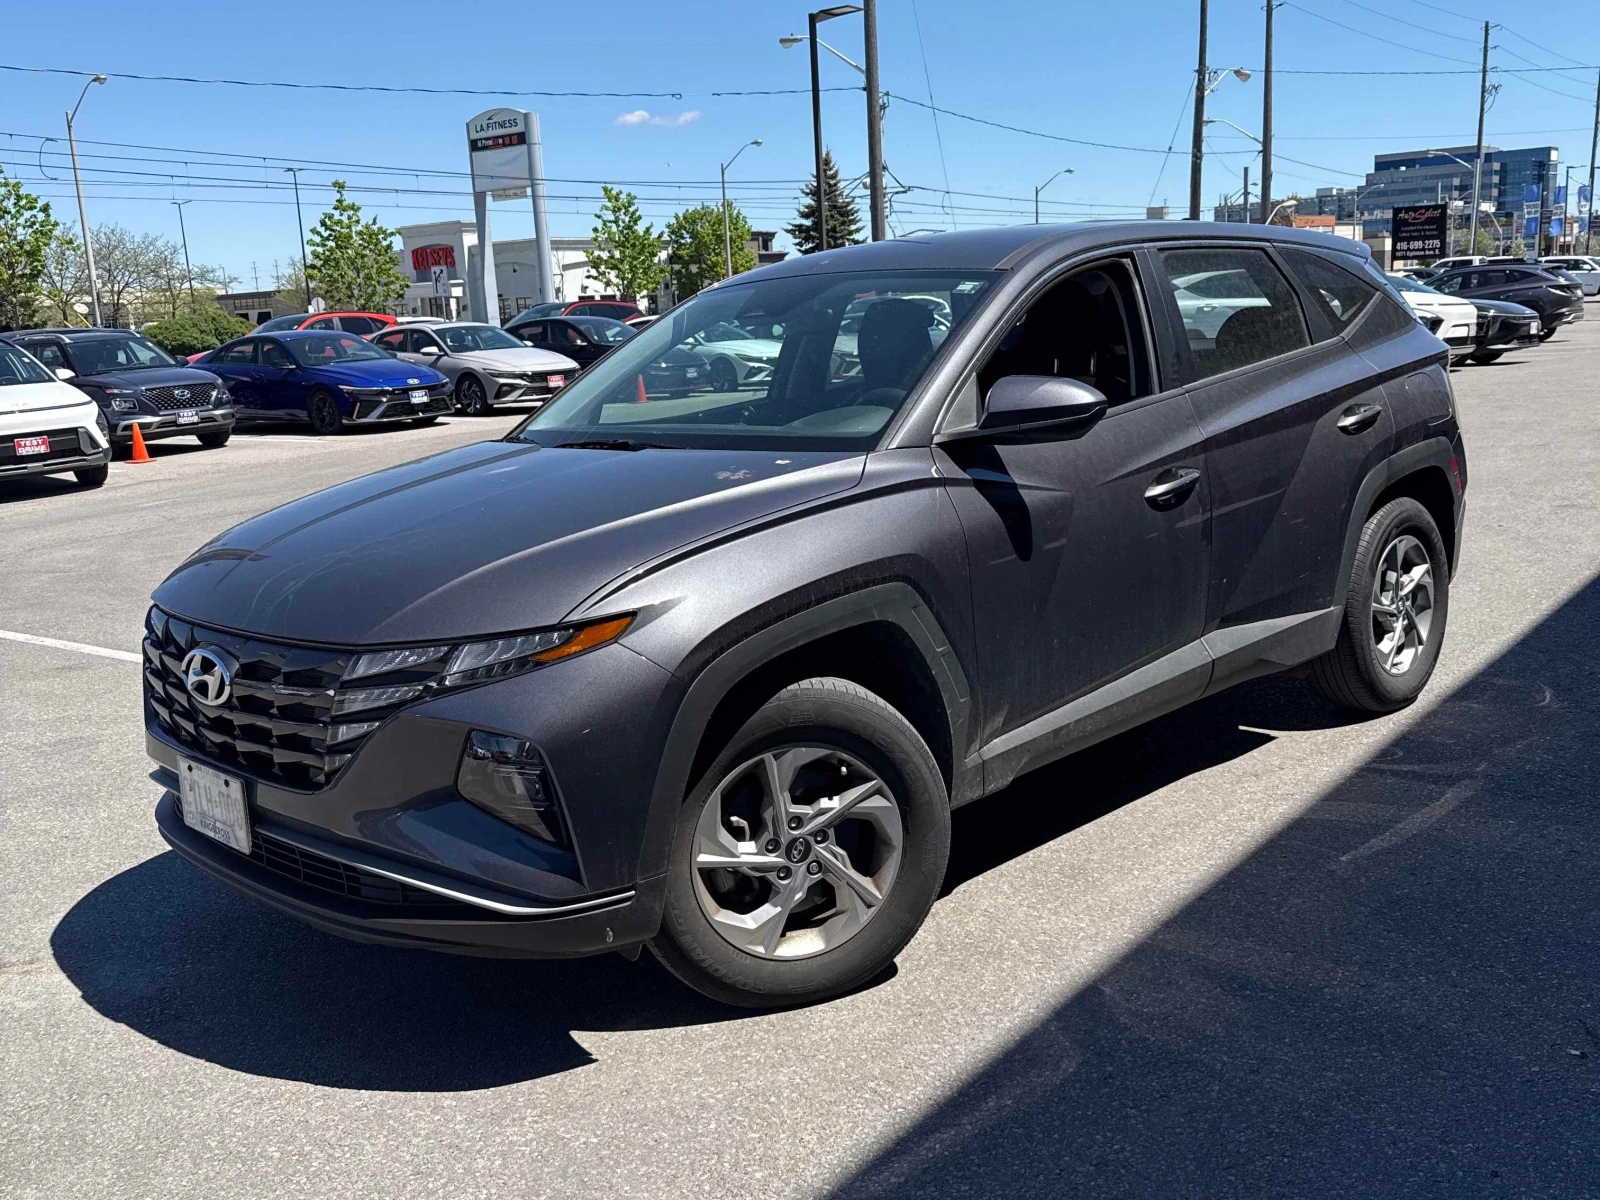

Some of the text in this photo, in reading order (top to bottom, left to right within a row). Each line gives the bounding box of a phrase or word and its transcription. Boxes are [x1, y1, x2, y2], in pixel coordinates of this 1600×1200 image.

[475, 118, 518, 133] LA FITNESS
[1396, 240, 1440, 250] 416-699-2275
[19, 439, 44, 447] TEST
[18, 444, 47, 454] DRIVE
